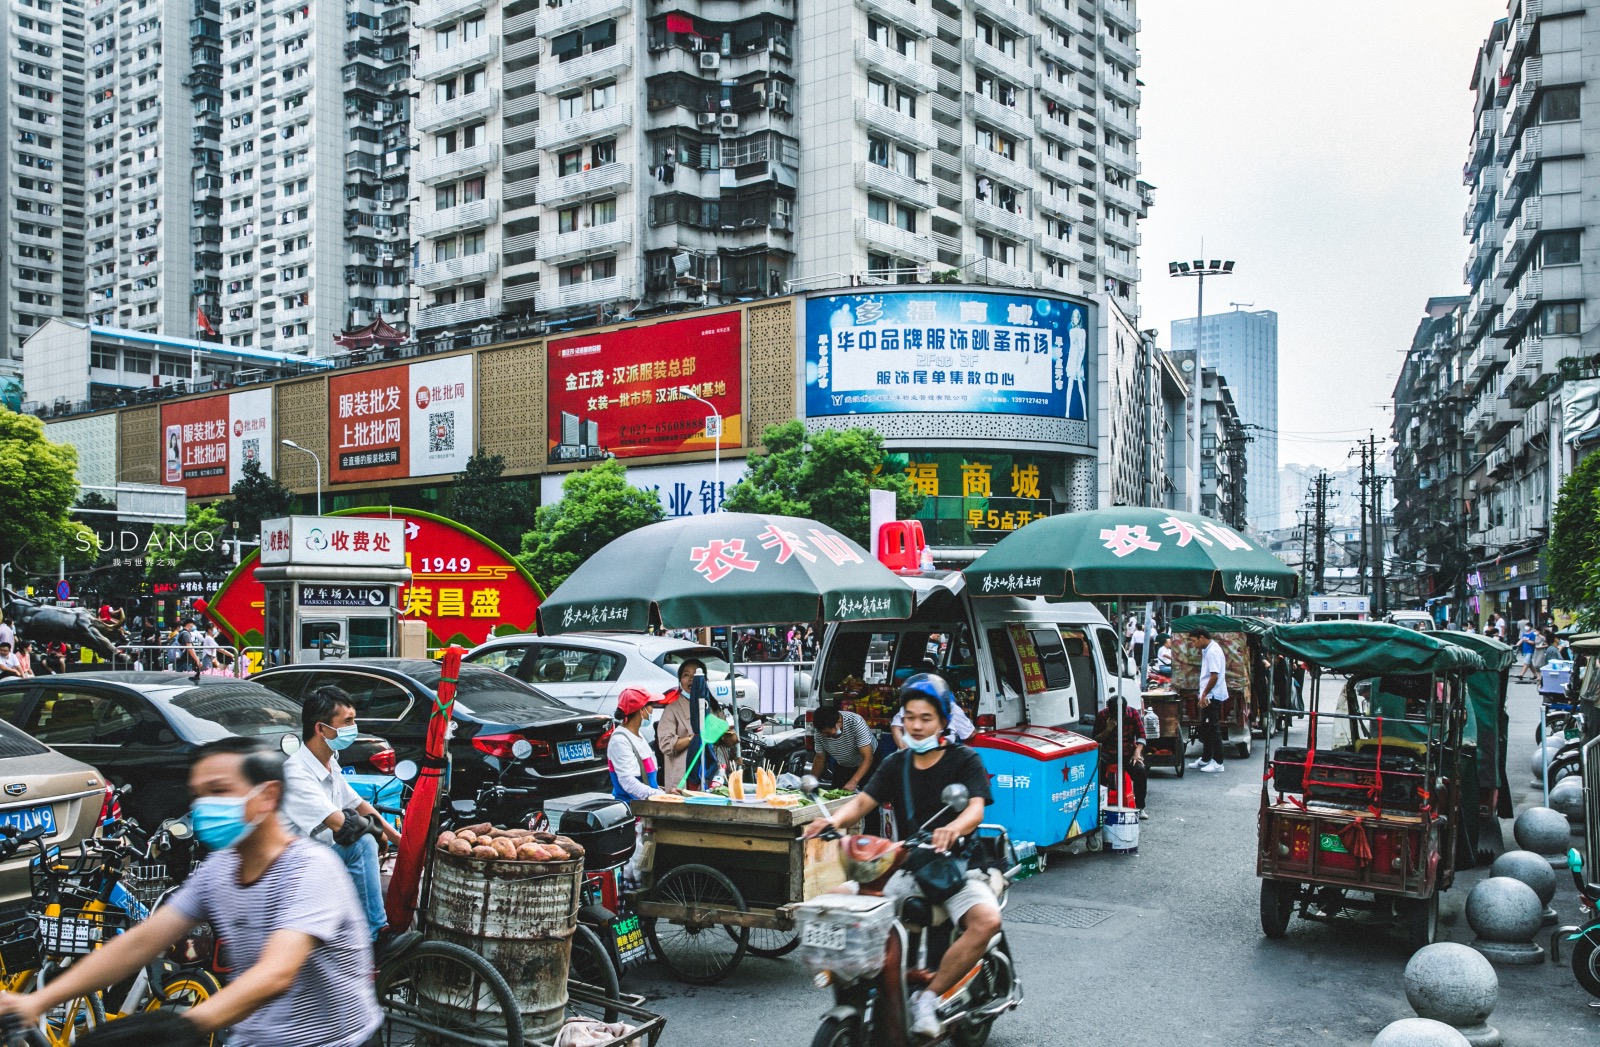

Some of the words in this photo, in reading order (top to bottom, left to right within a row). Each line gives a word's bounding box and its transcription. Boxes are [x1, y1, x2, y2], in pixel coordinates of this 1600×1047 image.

[837, 328, 1049, 354] 华中品牌服饰跳蚤市场
[877, 370, 1015, 386] 服饰尾单集散中心
[338, 386, 401, 418] 服装批发
[431, 383, 465, 401] 批批网
[587, 390, 653, 412] 女装一批市场
[183, 419, 226, 443] 服装批发
[244, 418, 266, 431] 批批网
[338, 418, 400, 448] 上批批网
[183, 443, 226, 465] 上批批网
[870, 461, 1040, 499] 福商城
[270, 531, 289, 551] 收费处
[331, 530, 391, 552] 收费处
[421, 557, 471, 573] 1949
[303, 587, 368, 600] 停车场入口
[403, 586, 500, 617] 荣昌盛
[1023, 661, 1041, 677] 有售
[996, 774, 1031, 789] 雪帝
[1070, 763, 1085, 782] 雪帝
